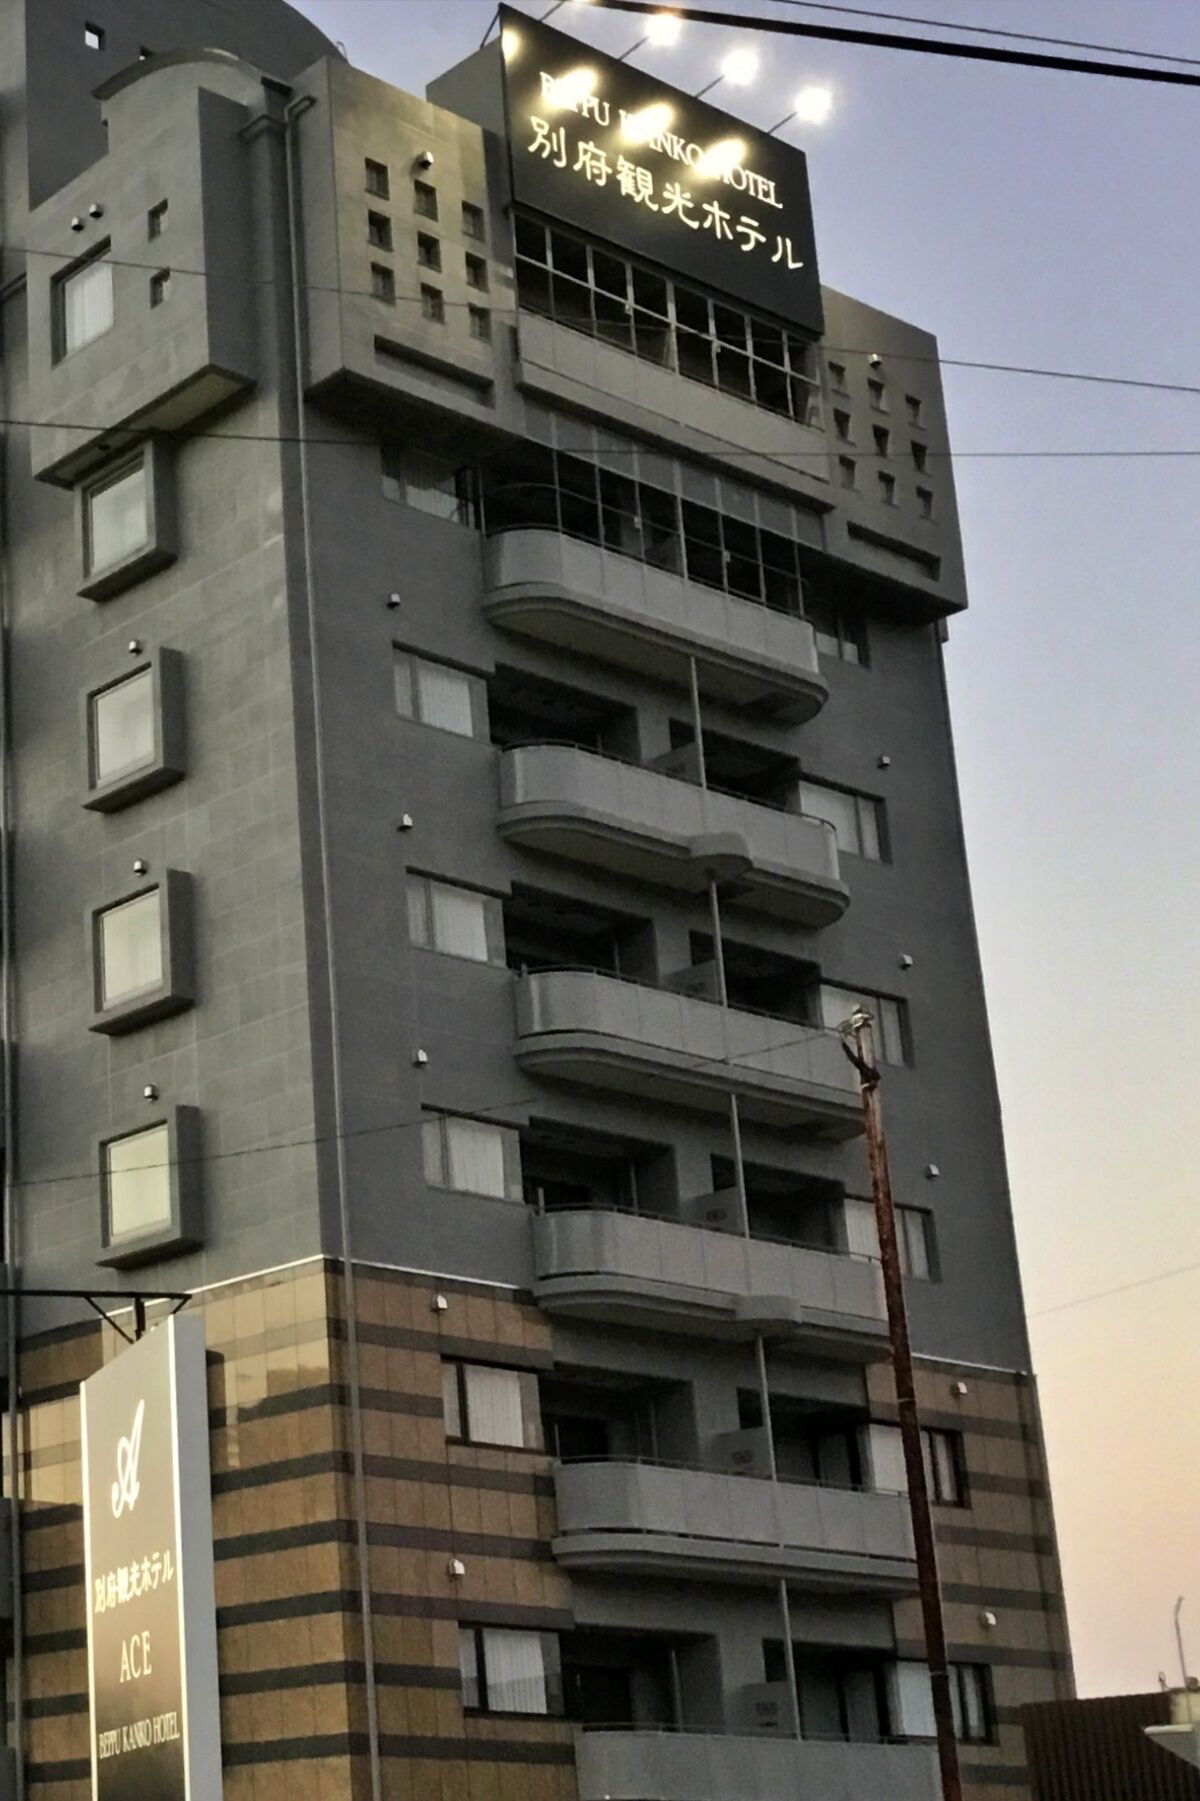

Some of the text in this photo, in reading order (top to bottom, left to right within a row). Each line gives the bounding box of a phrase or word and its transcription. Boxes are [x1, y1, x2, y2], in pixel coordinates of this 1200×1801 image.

[539, 71, 783, 209] BPU NKO OTEL
[527, 115, 804, 270] 別府観光ホテル
[94, 1549, 175, 1614] 別府観光ホテル
[119, 1629, 153, 1684] ACE
[153, 1710, 180, 1745] HOTEL
